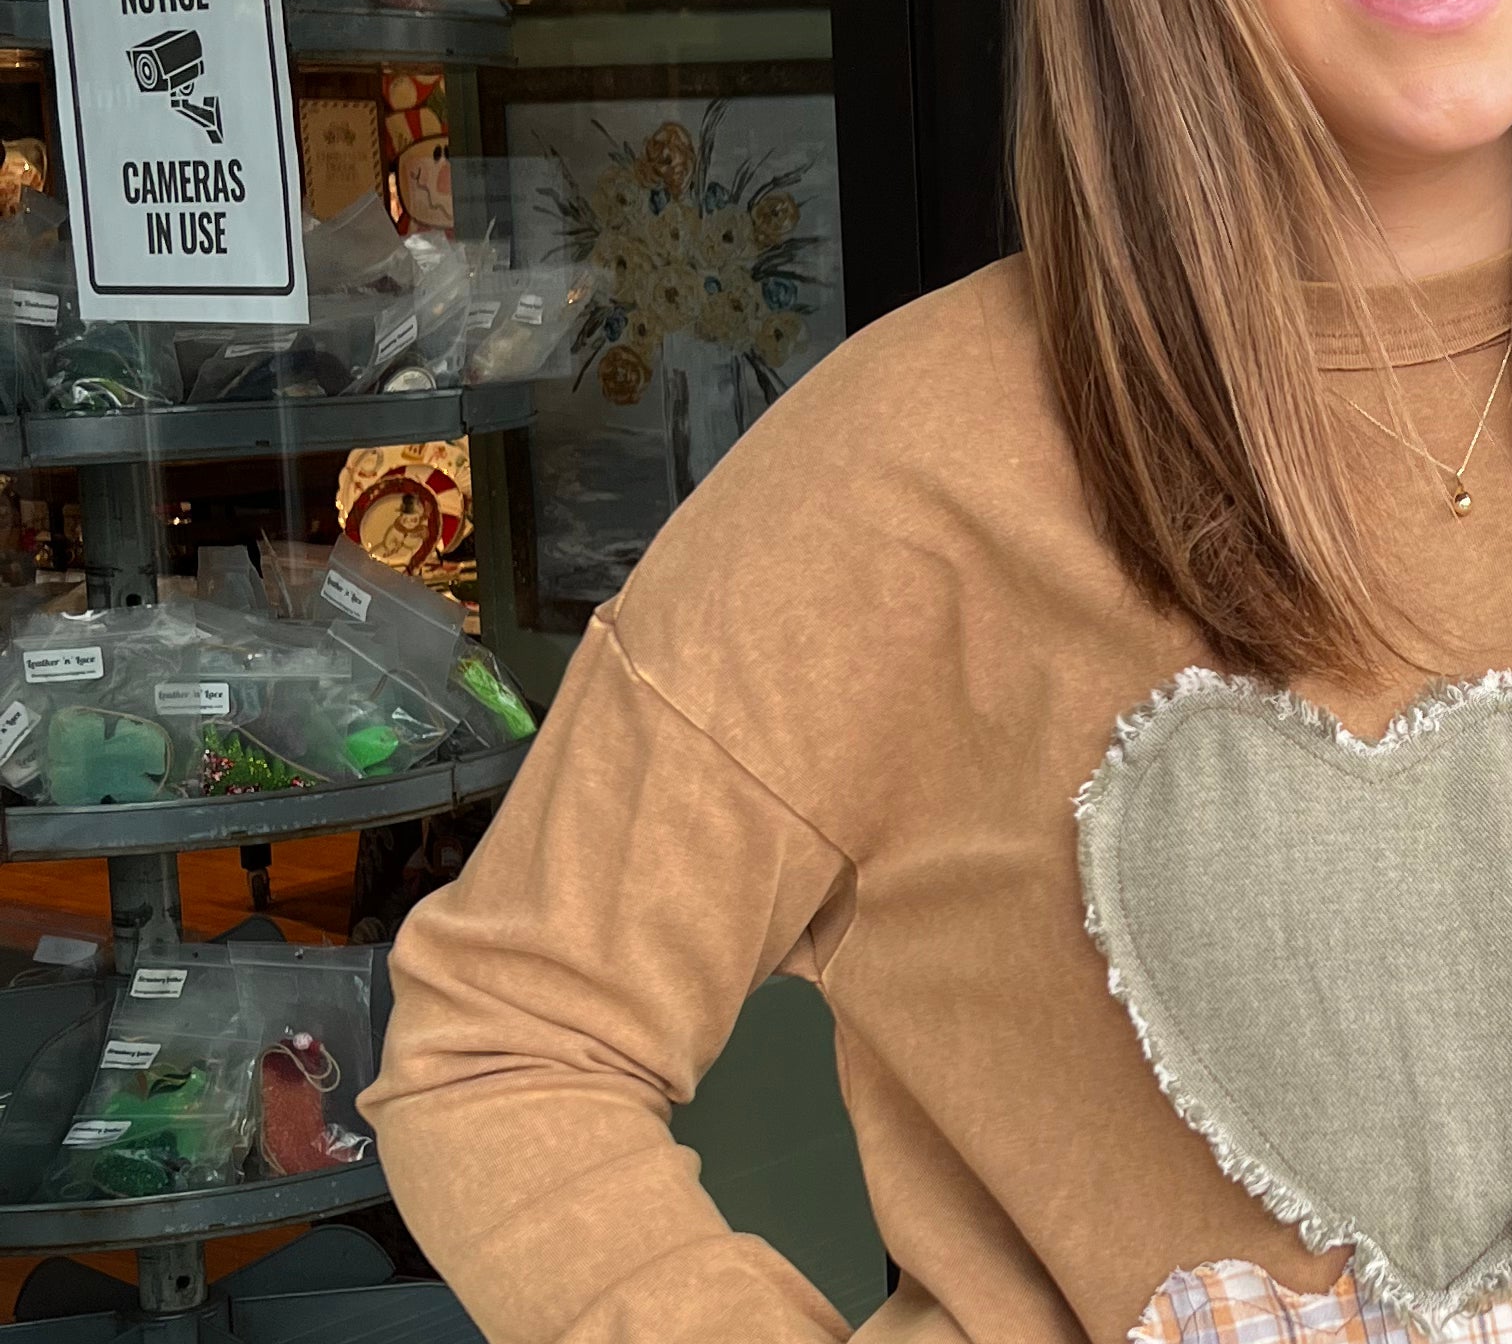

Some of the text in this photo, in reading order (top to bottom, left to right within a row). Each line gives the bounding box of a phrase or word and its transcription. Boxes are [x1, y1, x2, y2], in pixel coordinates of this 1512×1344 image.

[122, 158, 246, 204] CAMERAS
[146, 211, 228, 254] IN USE
